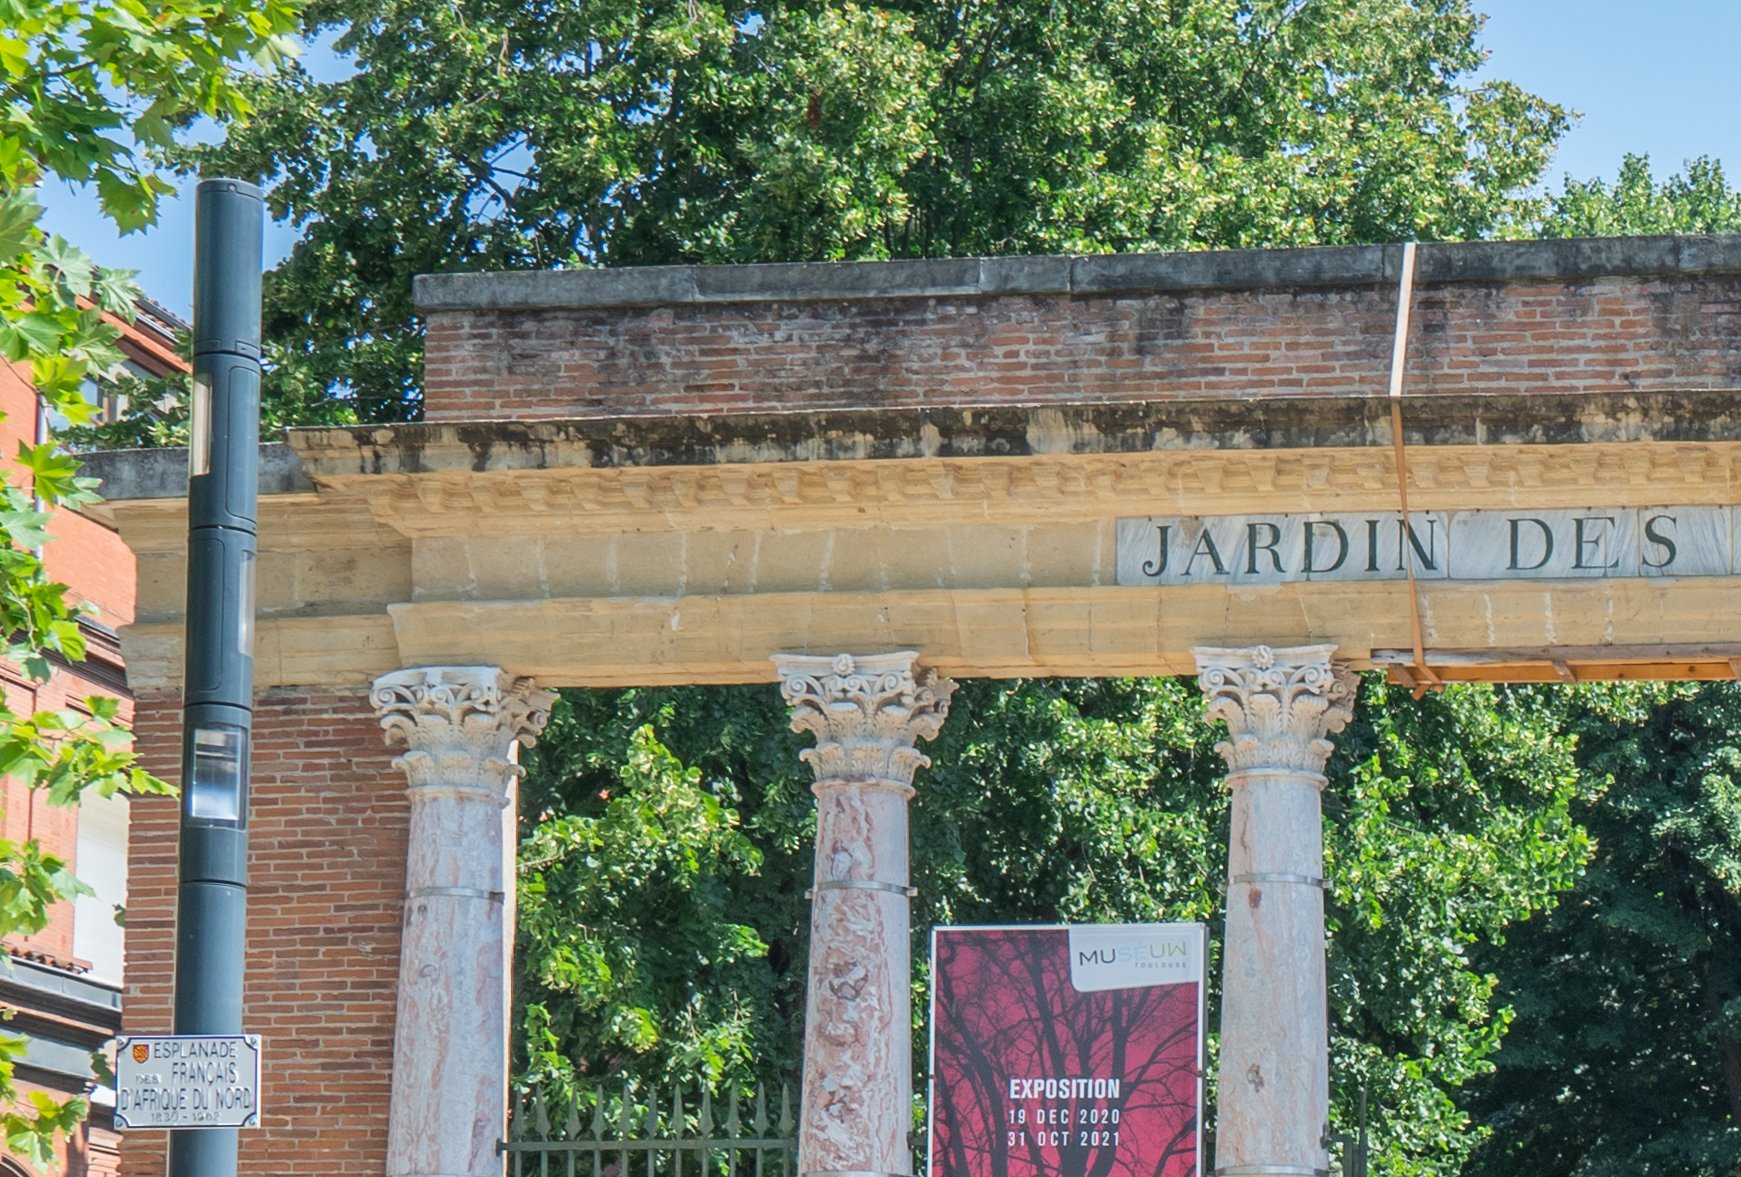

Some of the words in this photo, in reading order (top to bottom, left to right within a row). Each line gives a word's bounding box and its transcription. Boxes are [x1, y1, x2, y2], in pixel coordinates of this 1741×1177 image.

[1142, 518, 1437, 577] JARDIN
[1506, 515, 1677, 571] DES
[154, 1041, 237, 1059] ESPLANADE
[136, 1074, 159, 1085] DES
[172, 1062, 238, 1086] FRANÇAIS
[121, 1088, 187, 1110] D'AFRIQUE
[193, 1088, 209, 1109] DU
[216, 1087, 252, 1110] NORD
[1010, 1079, 1120, 1099] EXPOSITION
[1009, 1109, 1026, 1124] 19
[1037, 1109, 1069, 1124] DEC
[1080, 1109, 1120, 1124] 2020
[1008, 1131, 1025, 1146] 31
[1038, 1131, 1069, 1146] OCT
[1080, 1131, 1119, 1146] 2021
